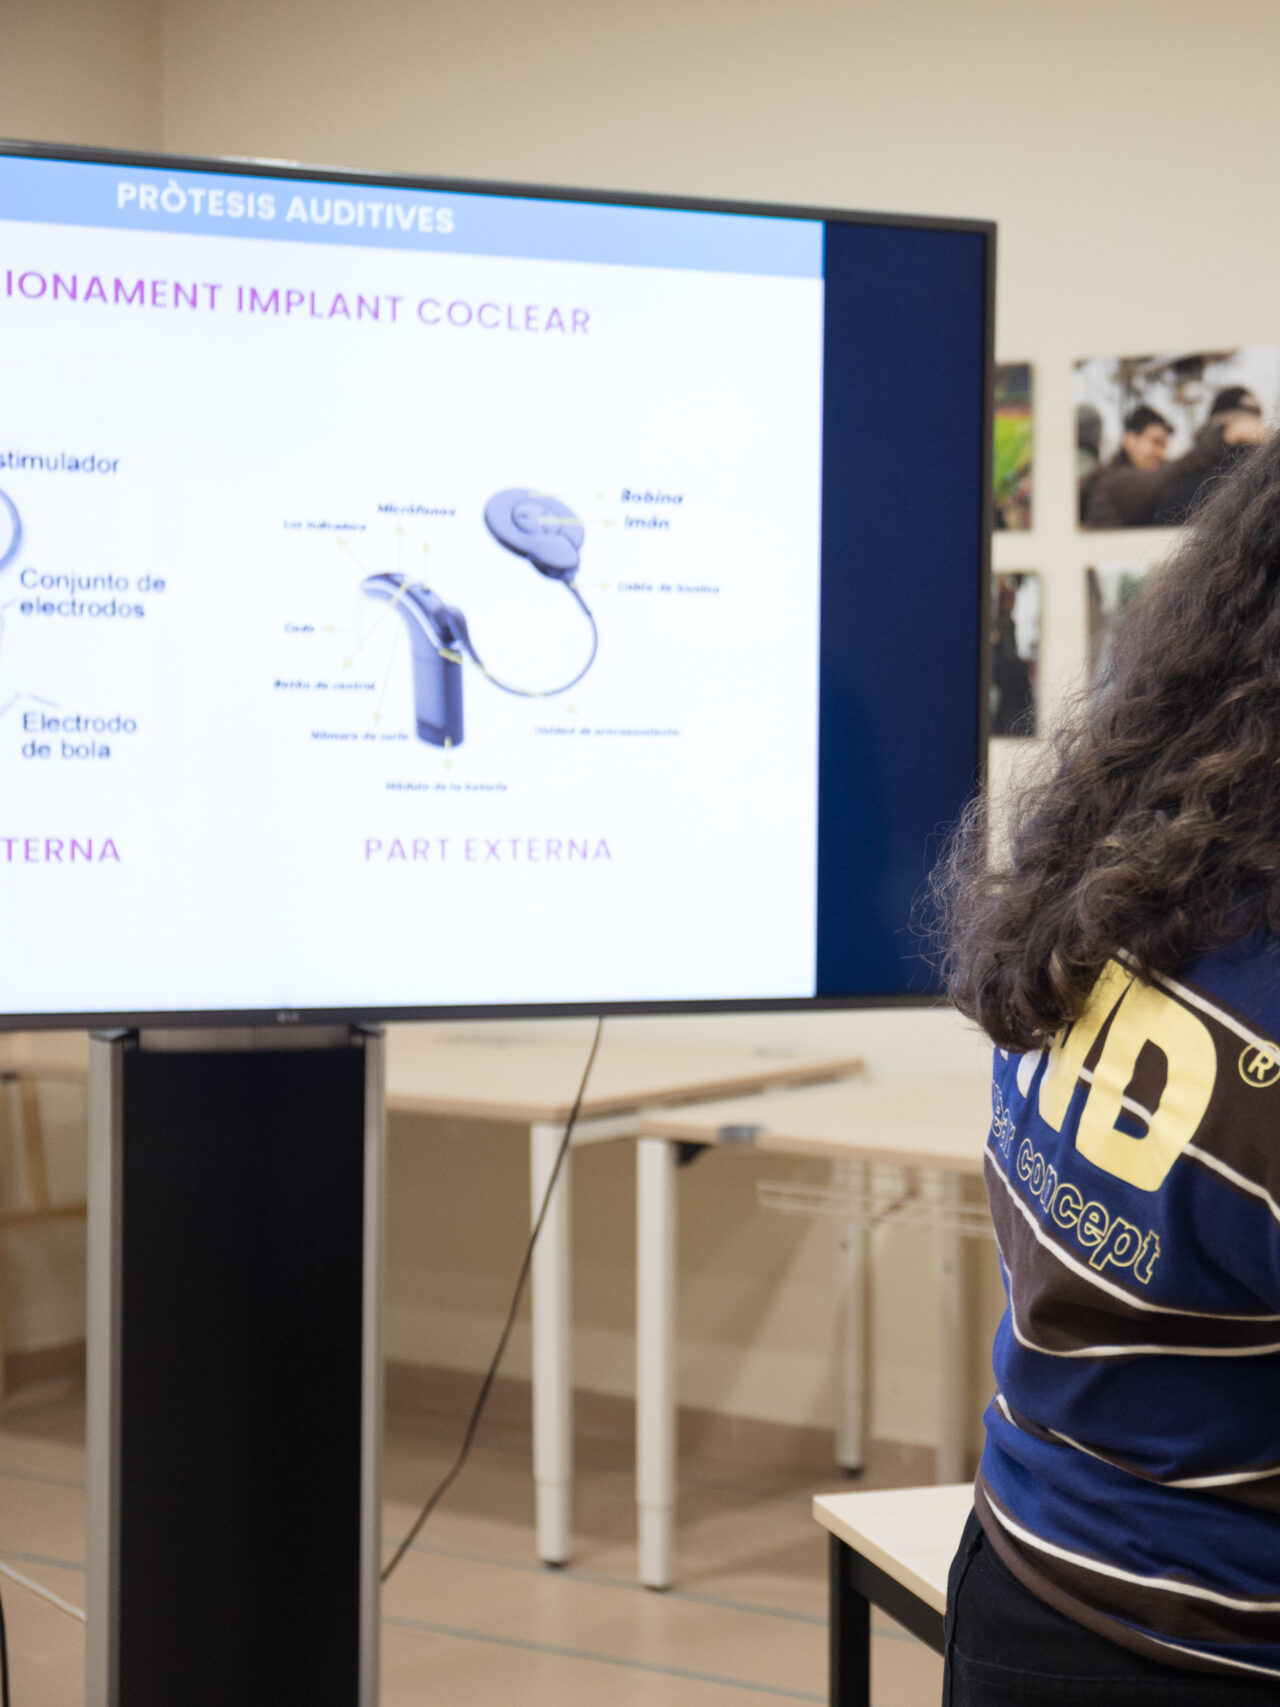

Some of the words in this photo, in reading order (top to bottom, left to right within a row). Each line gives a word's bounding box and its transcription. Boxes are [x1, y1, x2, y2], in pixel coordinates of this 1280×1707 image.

[117, 179, 277, 221] PRÒTESIS
[285, 195, 456, 235] AUDITIVES
[5, 268, 224, 312] IONAMENT
[235, 283, 405, 323] IMPLANT
[416, 297, 591, 335] COCLEAR
[620, 488, 684, 505] Bobina
[20, 567, 130, 597] Conjunto
[137, 574, 167, 593] de
[20, 596, 145, 619] electrodos
[22, 711, 138, 733] Electrodo
[22, 740, 51, 759] de
[61, 740, 111, 759] bola
[0, 836, 121, 863] TERNA
[364, 837, 451, 862] PART
[463, 837, 613, 863] EXTERNA
[1016, 1138, 1161, 1285] concept
